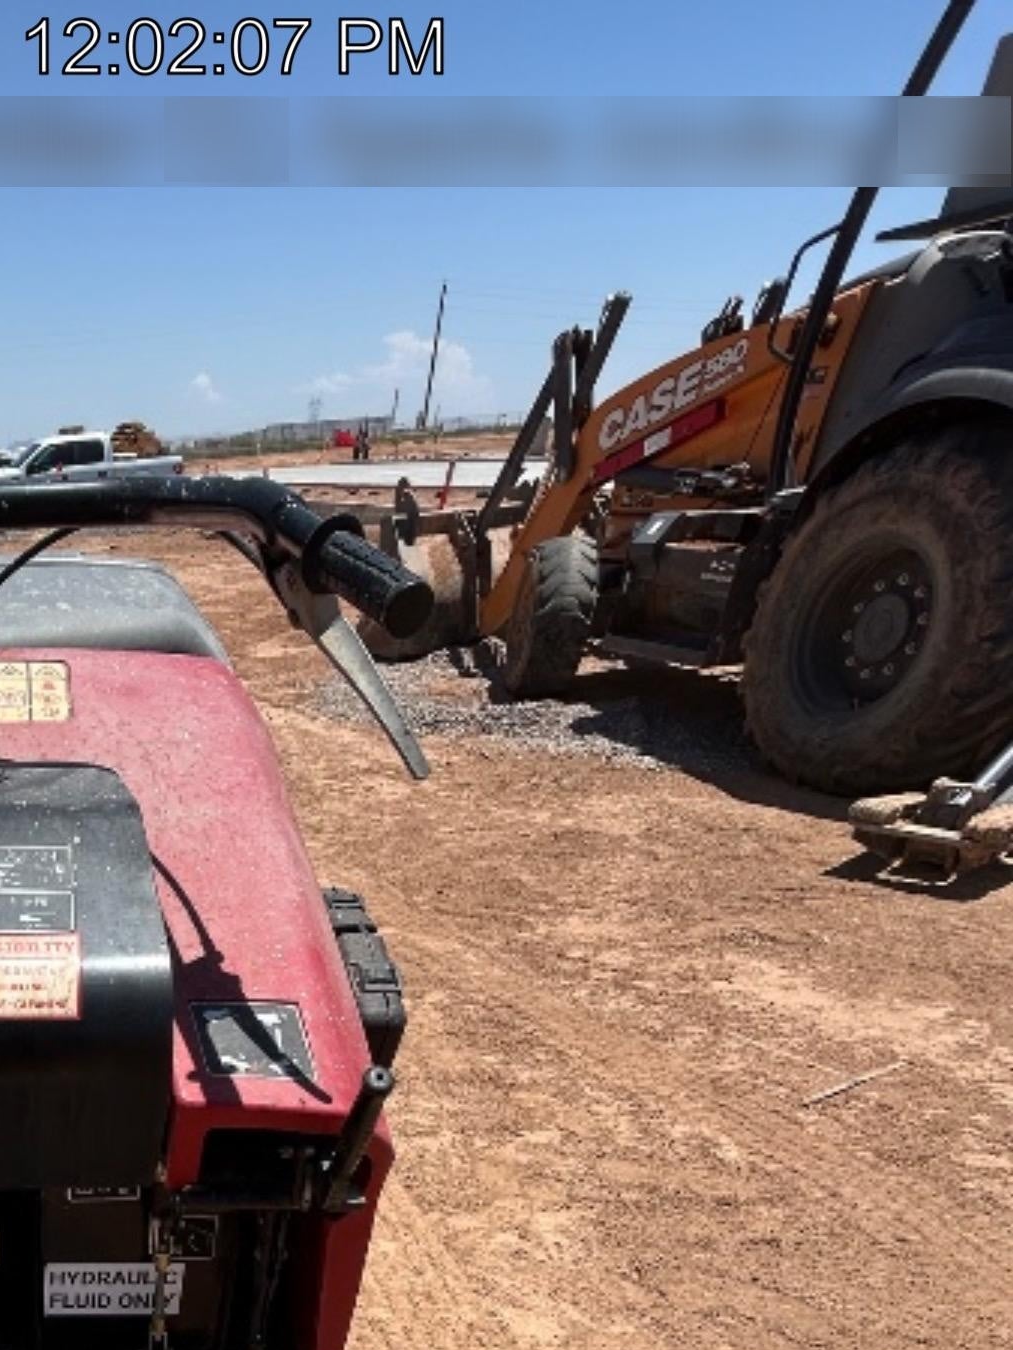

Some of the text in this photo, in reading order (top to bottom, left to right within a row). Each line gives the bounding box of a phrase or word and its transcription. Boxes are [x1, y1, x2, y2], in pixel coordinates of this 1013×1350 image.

[599, 359, 705, 450] CASE
[49, 1271, 178, 1285] HYDRAULC
[49, 1293, 110, 1309] FLUID
